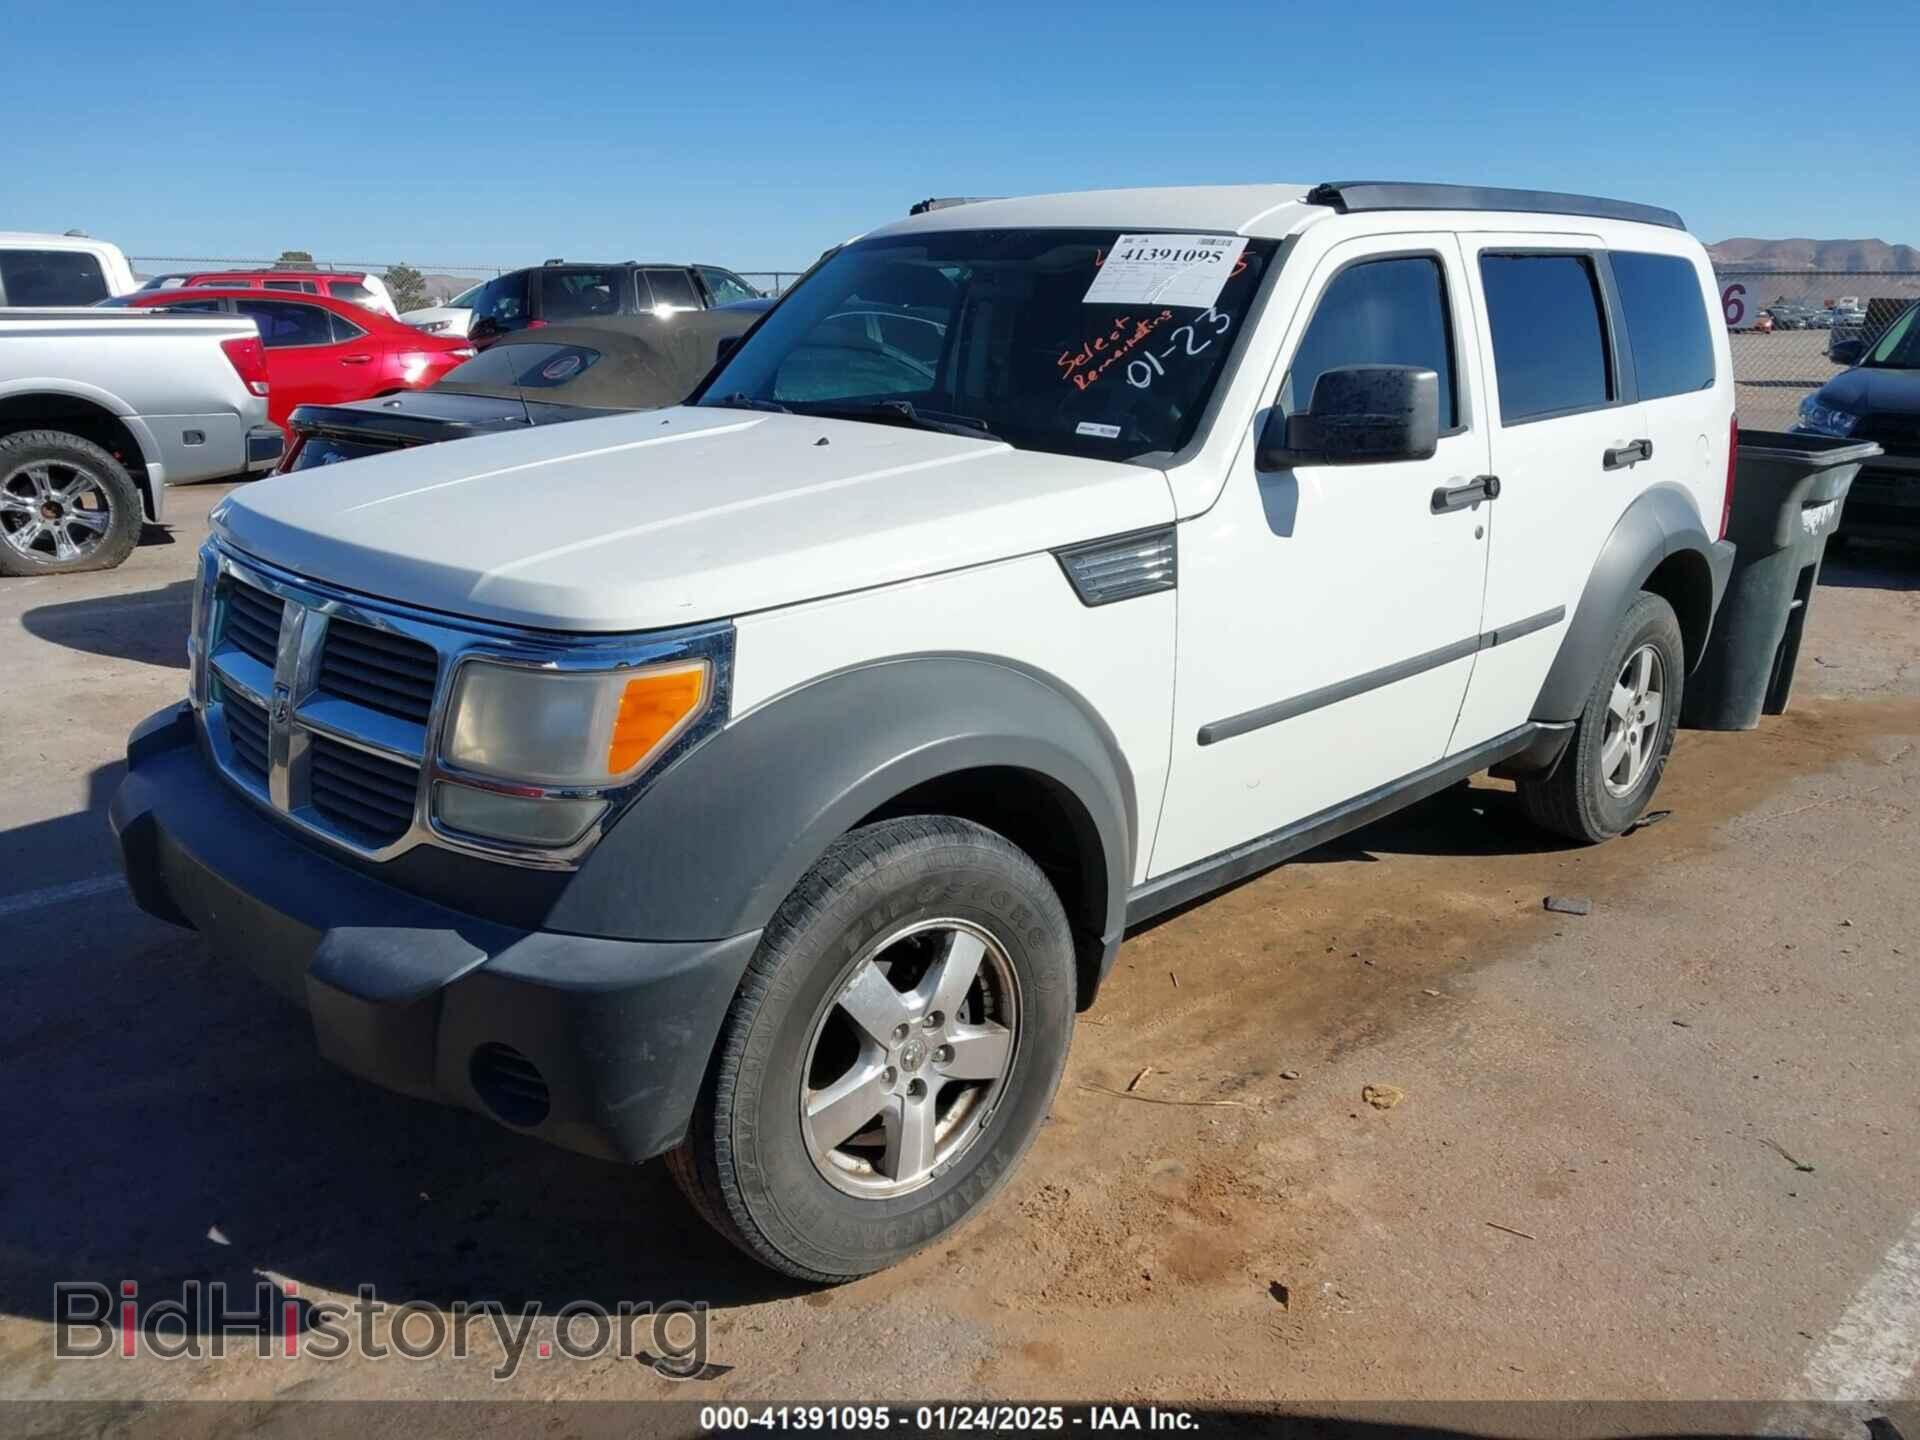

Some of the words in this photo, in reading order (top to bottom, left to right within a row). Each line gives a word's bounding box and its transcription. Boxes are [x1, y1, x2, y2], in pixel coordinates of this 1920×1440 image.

[1120, 247, 1223, 264] 41391095
[1722, 283, 1746, 325] 6
[1127, 307, 1231, 388] 01-23
